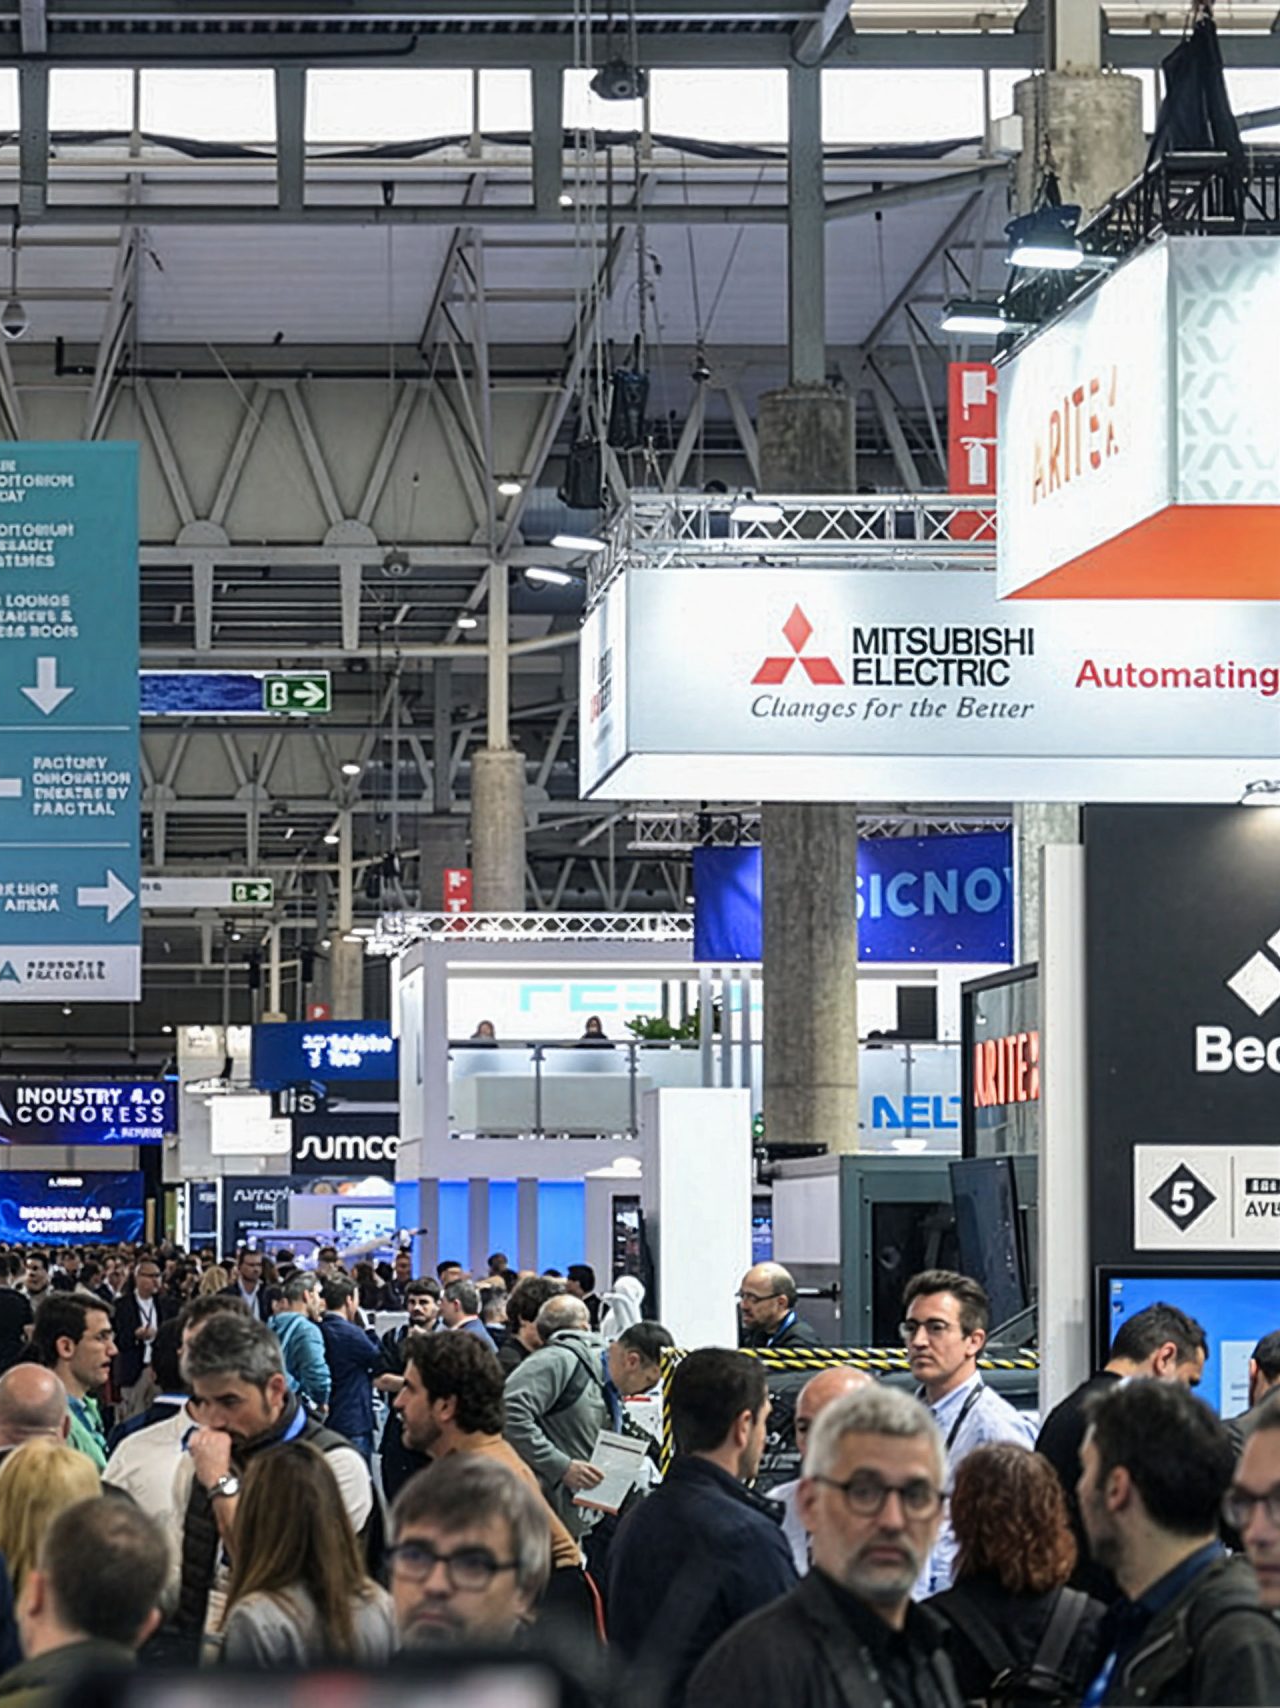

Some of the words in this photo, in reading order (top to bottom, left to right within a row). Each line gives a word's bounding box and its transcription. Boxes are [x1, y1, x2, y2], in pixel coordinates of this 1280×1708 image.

[852, 627, 1035, 656] MITSUBISHI
[852, 658, 1011, 686] ELECTRIC
[1075, 659, 1280, 697] Automating
[750, 694, 857, 723] Changes
[863, 696, 903, 721] for
[910, 697, 947, 718] the
[956, 696, 1035, 719] Better
[33, 756, 108, 770] FACTORY
[1170, 1180, 1195, 1217] 5
